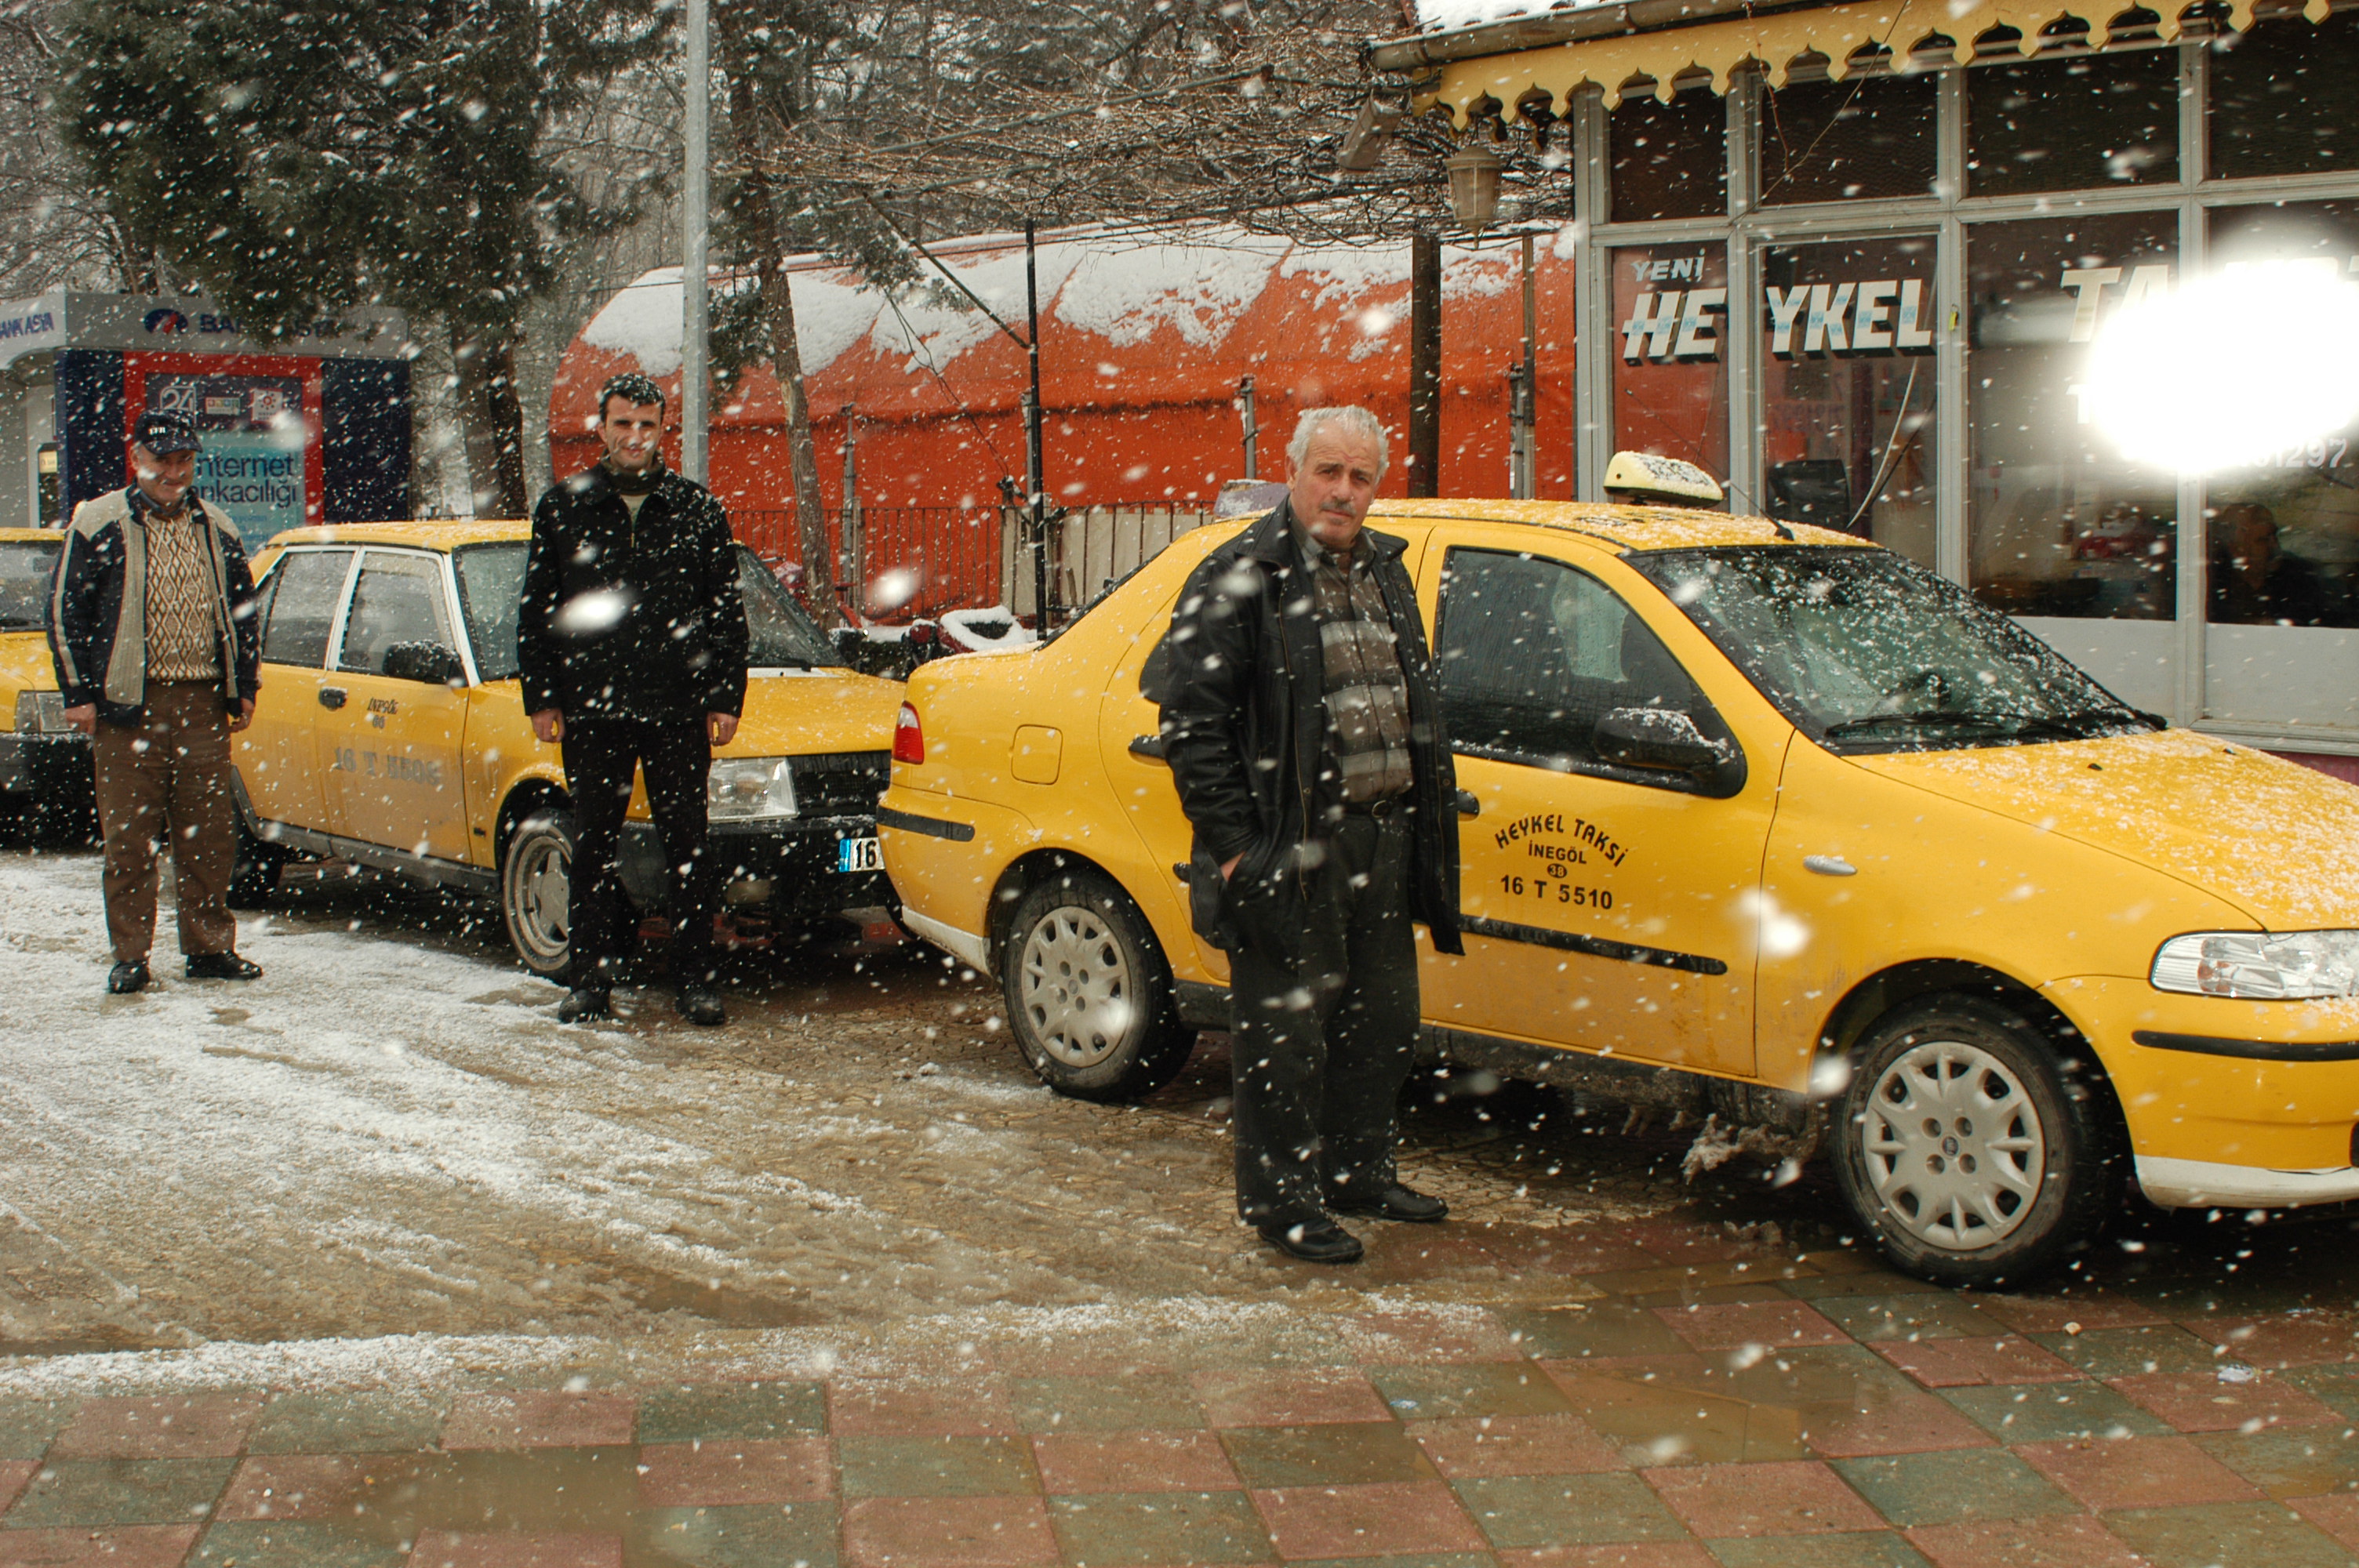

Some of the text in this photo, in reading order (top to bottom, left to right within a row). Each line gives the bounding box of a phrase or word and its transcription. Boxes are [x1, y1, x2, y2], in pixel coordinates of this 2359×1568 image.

[0, 312, 55, 339] ANK ASYA
[197, 454, 295, 477] nternet
[191, 479, 296, 509] ankacılığı
[856, 840, 878, 868] 16
[1494, 814, 1629, 867] HEYKEL TAKSİ
[1528, 840, 1587, 864] İNEGÖL
[1549, 864, 1565, 877] 38
[1500, 874, 1612, 909] 16 T 5510
